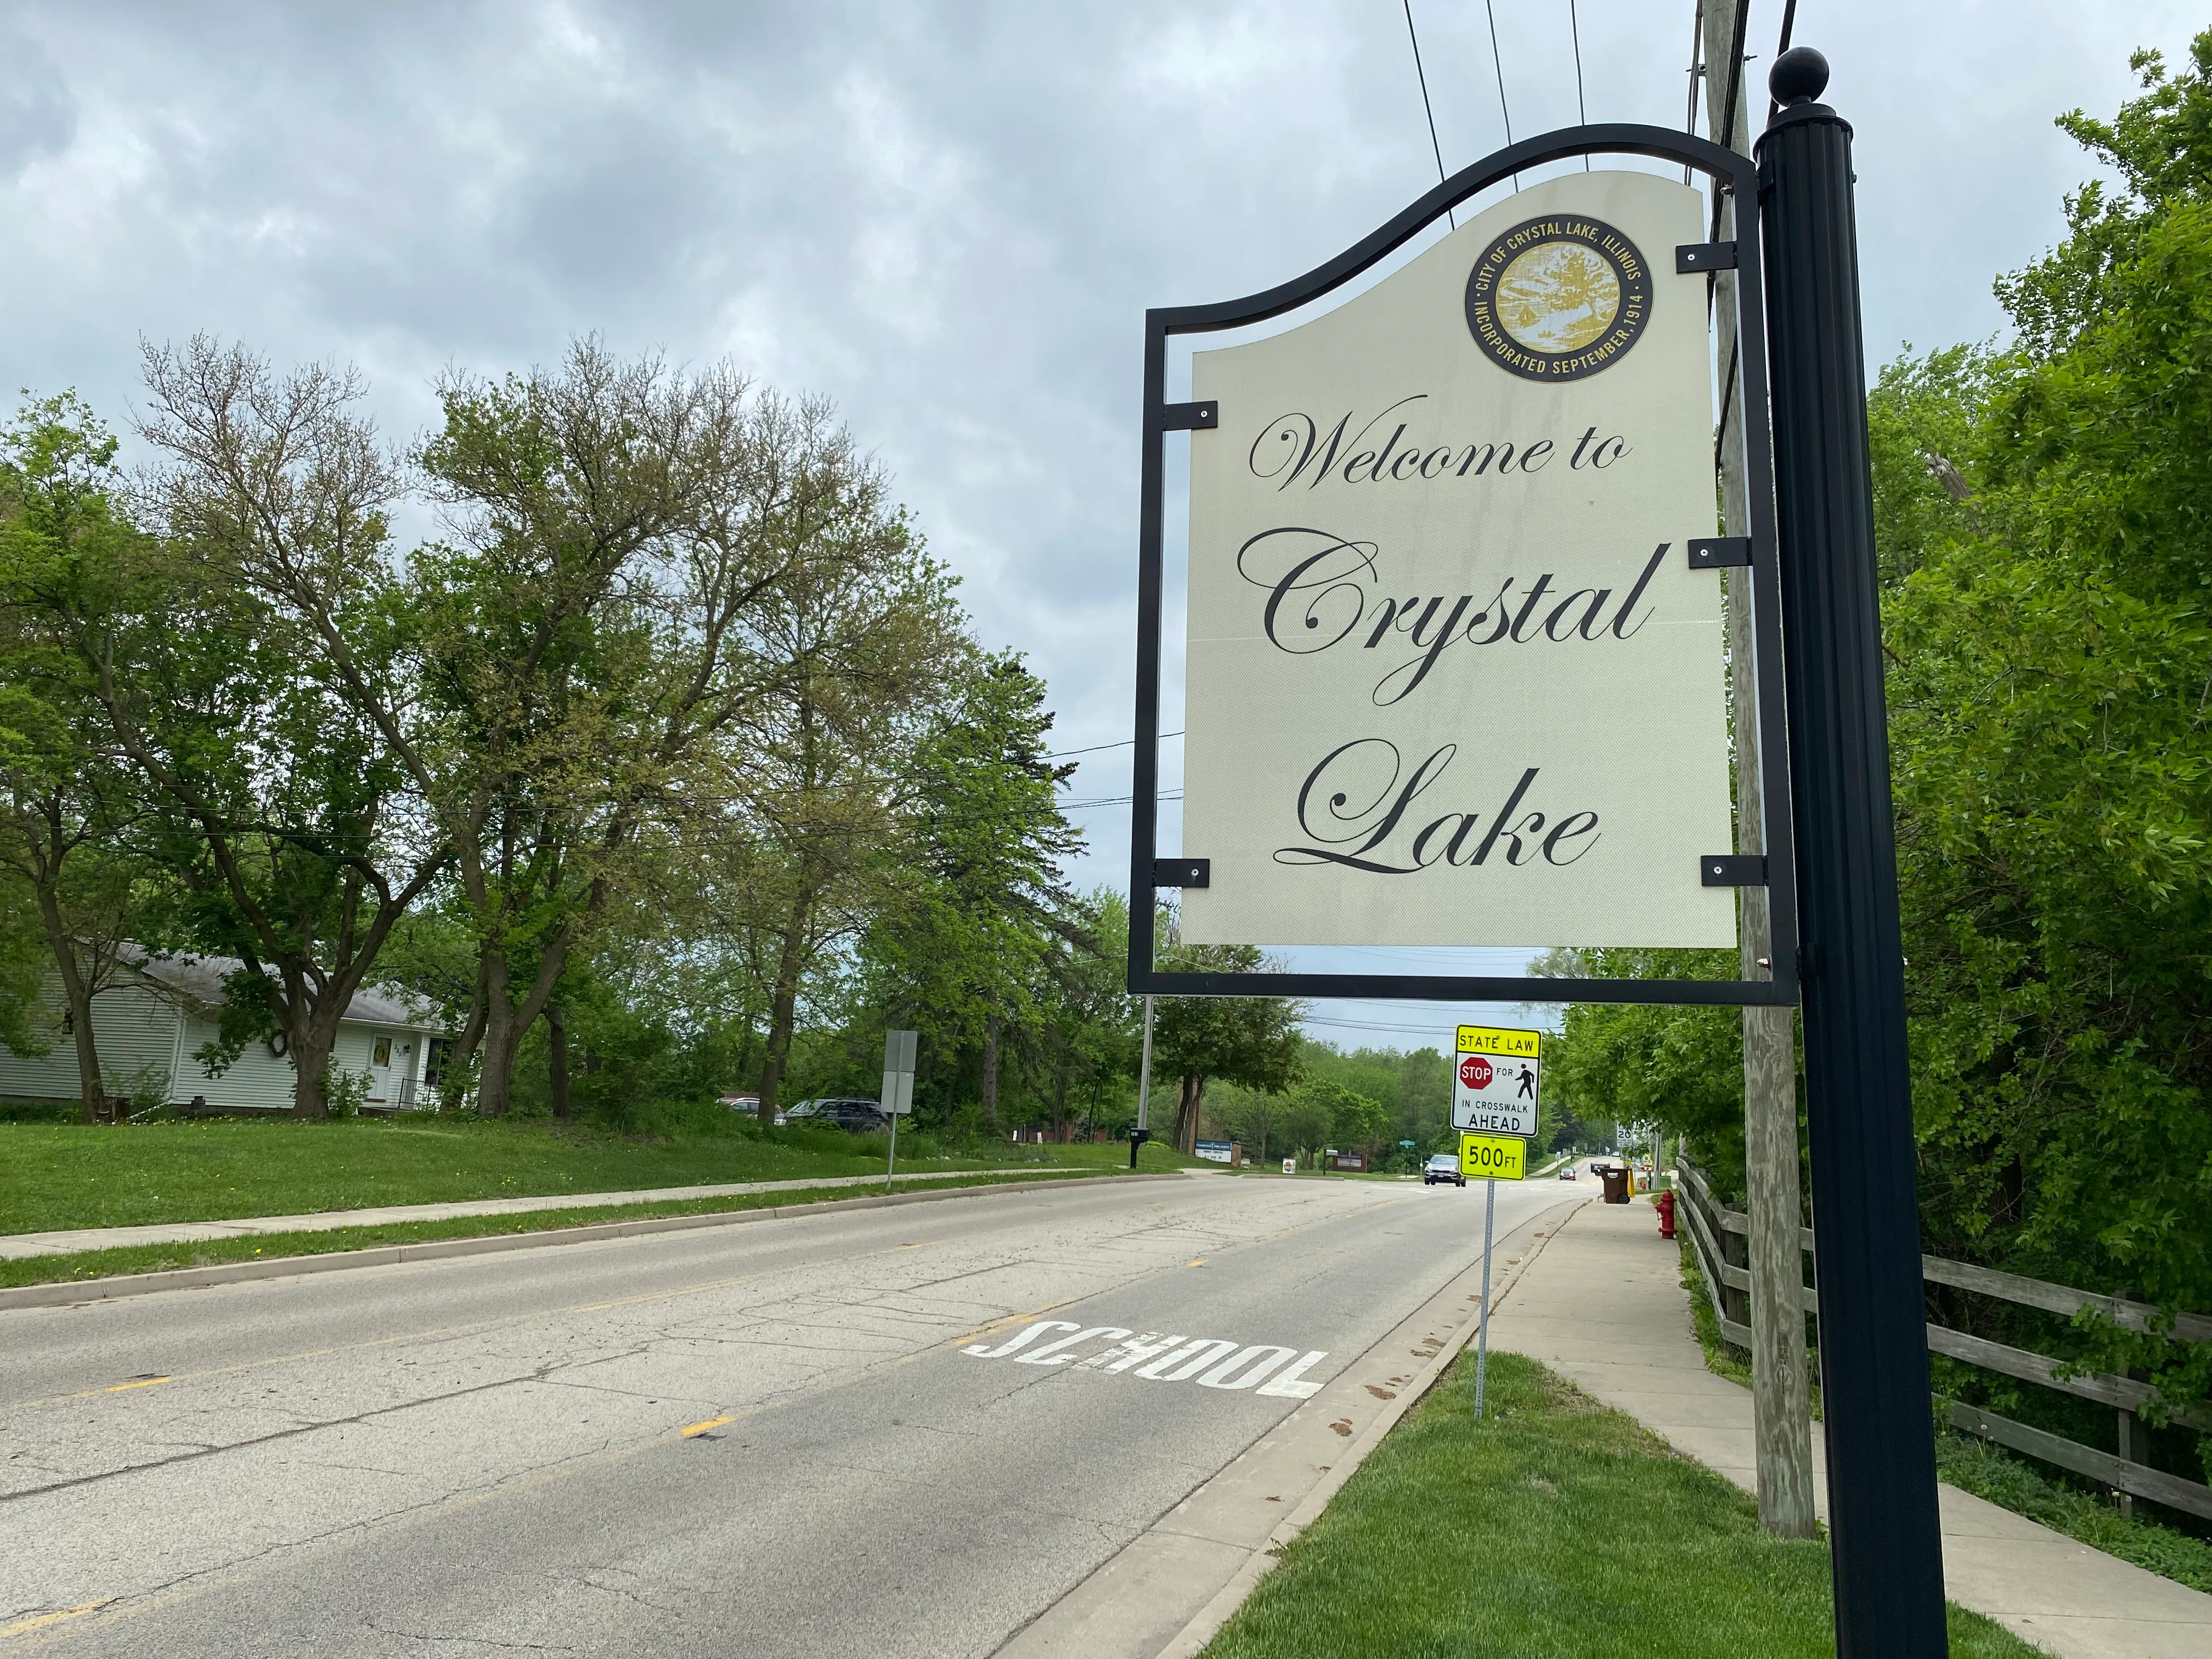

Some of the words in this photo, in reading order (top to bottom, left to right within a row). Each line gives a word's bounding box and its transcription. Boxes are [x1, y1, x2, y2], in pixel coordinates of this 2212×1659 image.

[1476, 262, 1496, 291] CITY
[1491, 246, 1508, 264] OF
[1507, 222, 1562, 251] CRYSTAL
[1566, 222, 1599, 243] LAKE,
[1601, 234, 1641, 281] ILLINOIS
[1474, 301, 1546, 374] INCORPORATED
[1623, 294, 1644, 326] 1914
[1249, 395, 1555, 492] Welcome
[1570, 427, 1633, 470] to
[1237, 527, 1672, 706] Crystal
[1273, 738, 1601, 873] Lake
[1460, 1035, 1499, 1049] STATE
[1507, 1039, 1534, 1052] LAW
[1462, 1066, 1491, 1080] STOP
[1497, 1068, 1514, 1077] FOR
[1462, 1099, 1470, 1108] IN
[1476, 1101, 1528, 1114] CROSSWALK
[1469, 1114, 1520, 1131] AHEAD
[959, 1321, 1330, 1400] SCHOOL
